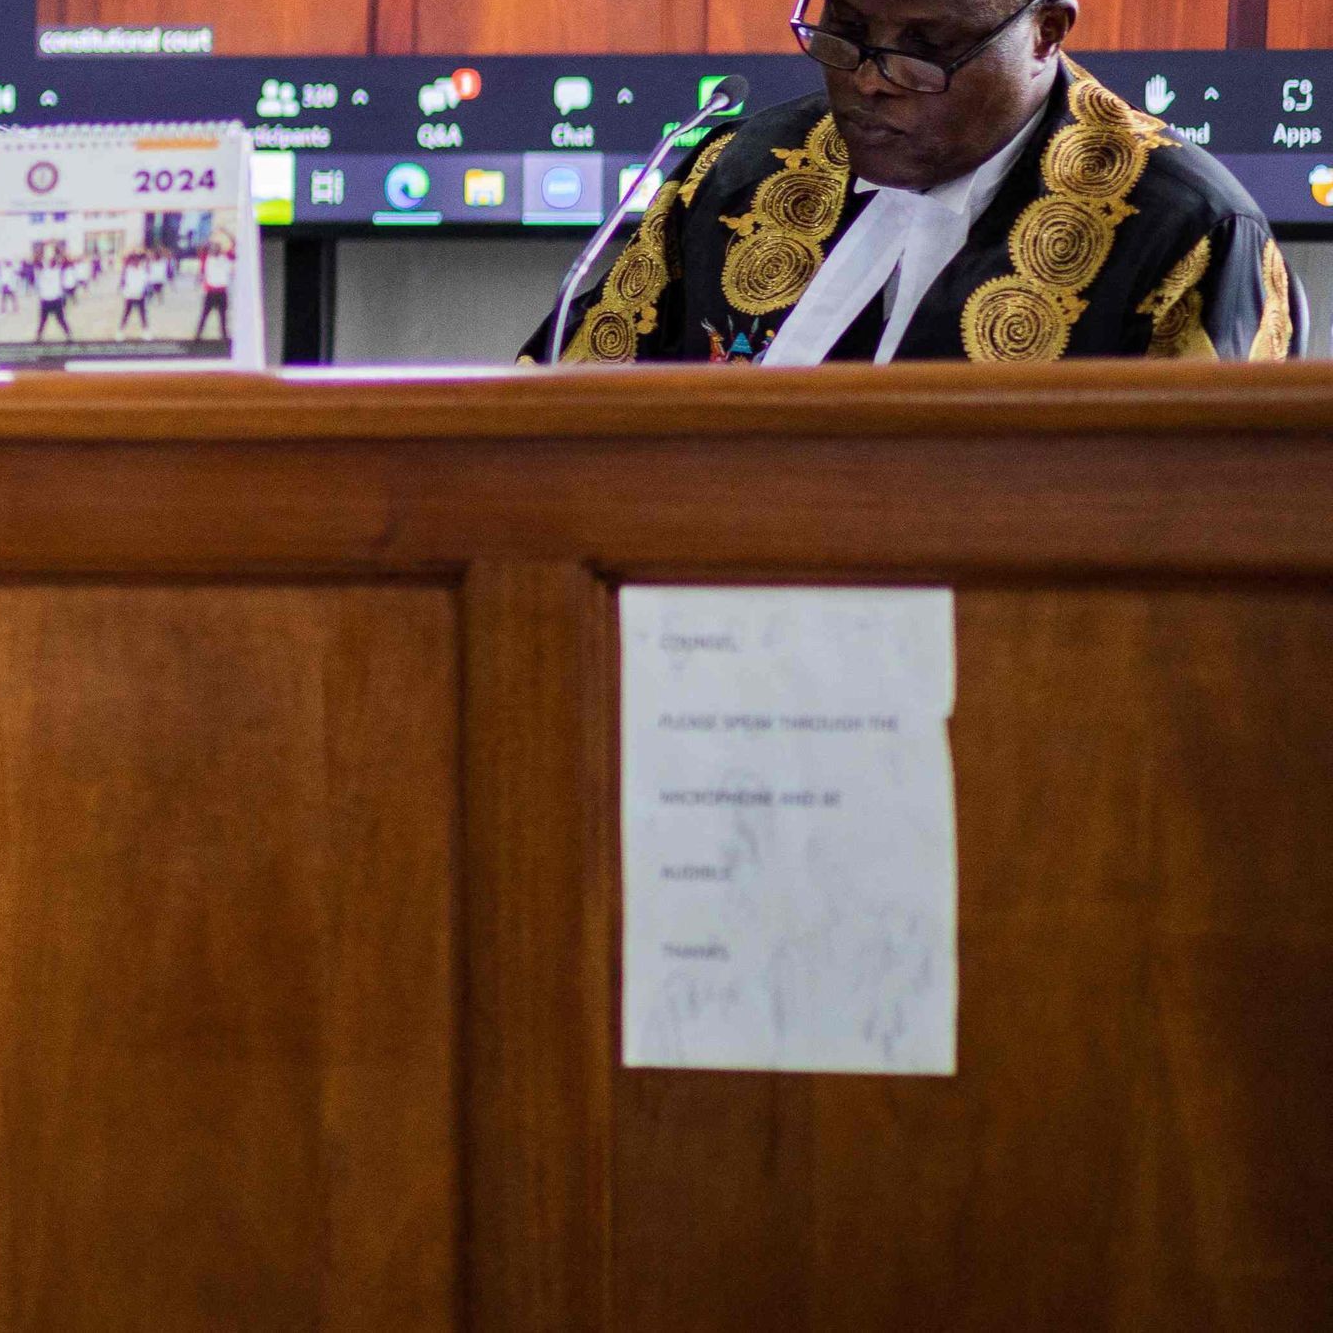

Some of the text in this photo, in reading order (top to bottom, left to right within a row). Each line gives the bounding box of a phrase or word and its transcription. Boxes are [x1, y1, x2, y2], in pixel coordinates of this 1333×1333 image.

[551, 124, 594, 148] Chat
[1273, 122, 1322, 148] Apps
[135, 168, 216, 192] 2024
